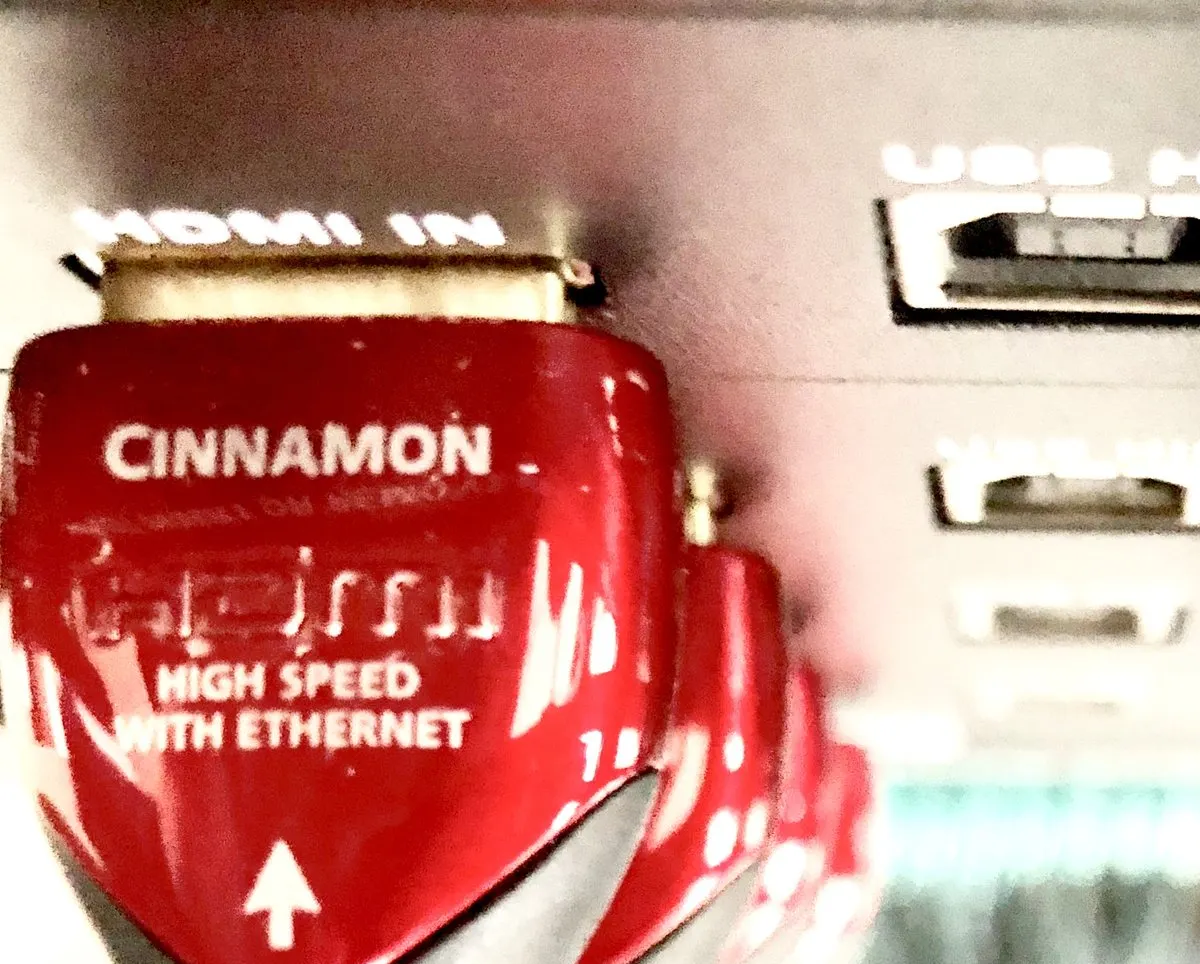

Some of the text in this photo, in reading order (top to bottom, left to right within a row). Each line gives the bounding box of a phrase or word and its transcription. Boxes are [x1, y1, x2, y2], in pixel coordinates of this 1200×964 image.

[881, 143, 1114, 187] USB
[68, 208, 505, 248] HDMI IN
[103, 422, 492, 482] CINNAMON
[155, 661, 422, 702] HIGH SPEED
[112, 708, 472, 754] WITH ETHERNET
